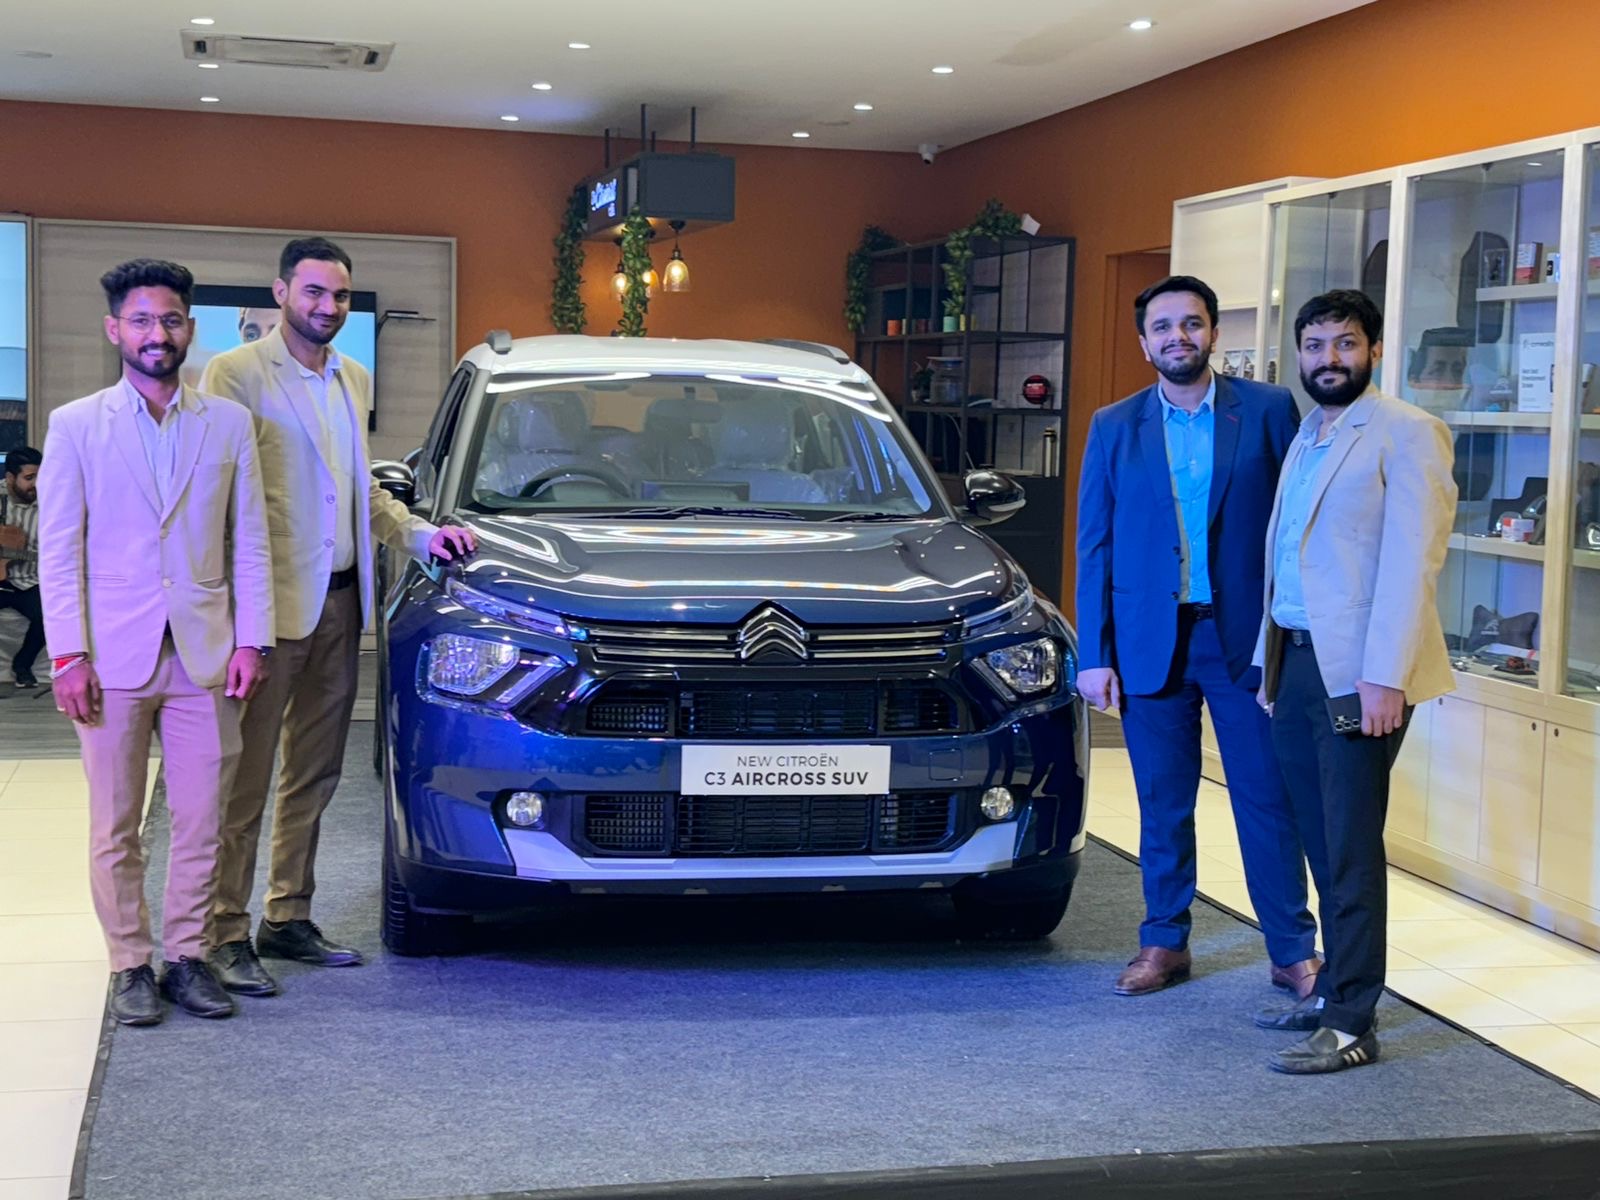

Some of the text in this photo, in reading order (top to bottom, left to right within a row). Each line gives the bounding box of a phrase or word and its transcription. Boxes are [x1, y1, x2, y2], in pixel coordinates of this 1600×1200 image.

[737, 752, 838, 767] NEW CITROËN
[704, 771, 869, 786] C3 AIRCROSS SUV
